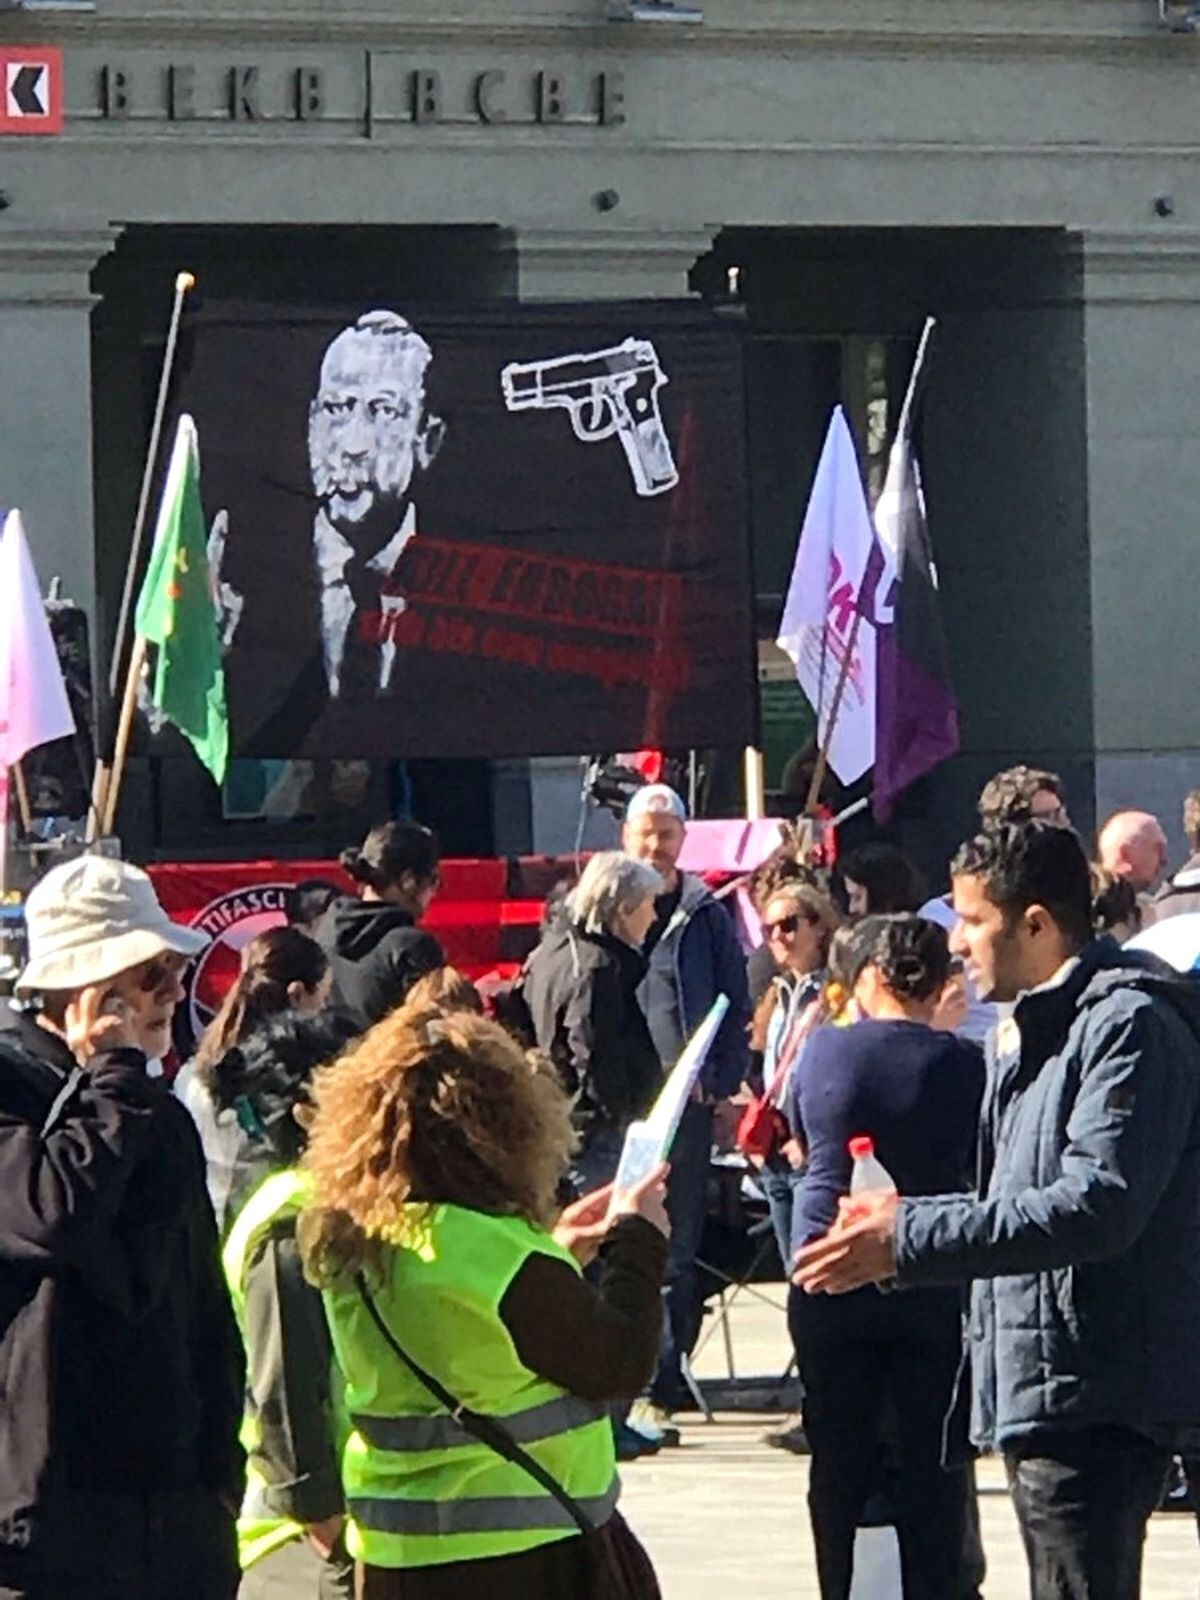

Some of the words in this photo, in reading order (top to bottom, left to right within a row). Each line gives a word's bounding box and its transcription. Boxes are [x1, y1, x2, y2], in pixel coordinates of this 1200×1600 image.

[100, 65, 323, 121] BEKB
[409, 69, 626, 126] BCBE
[198, 890, 286, 935] TIFASCI
